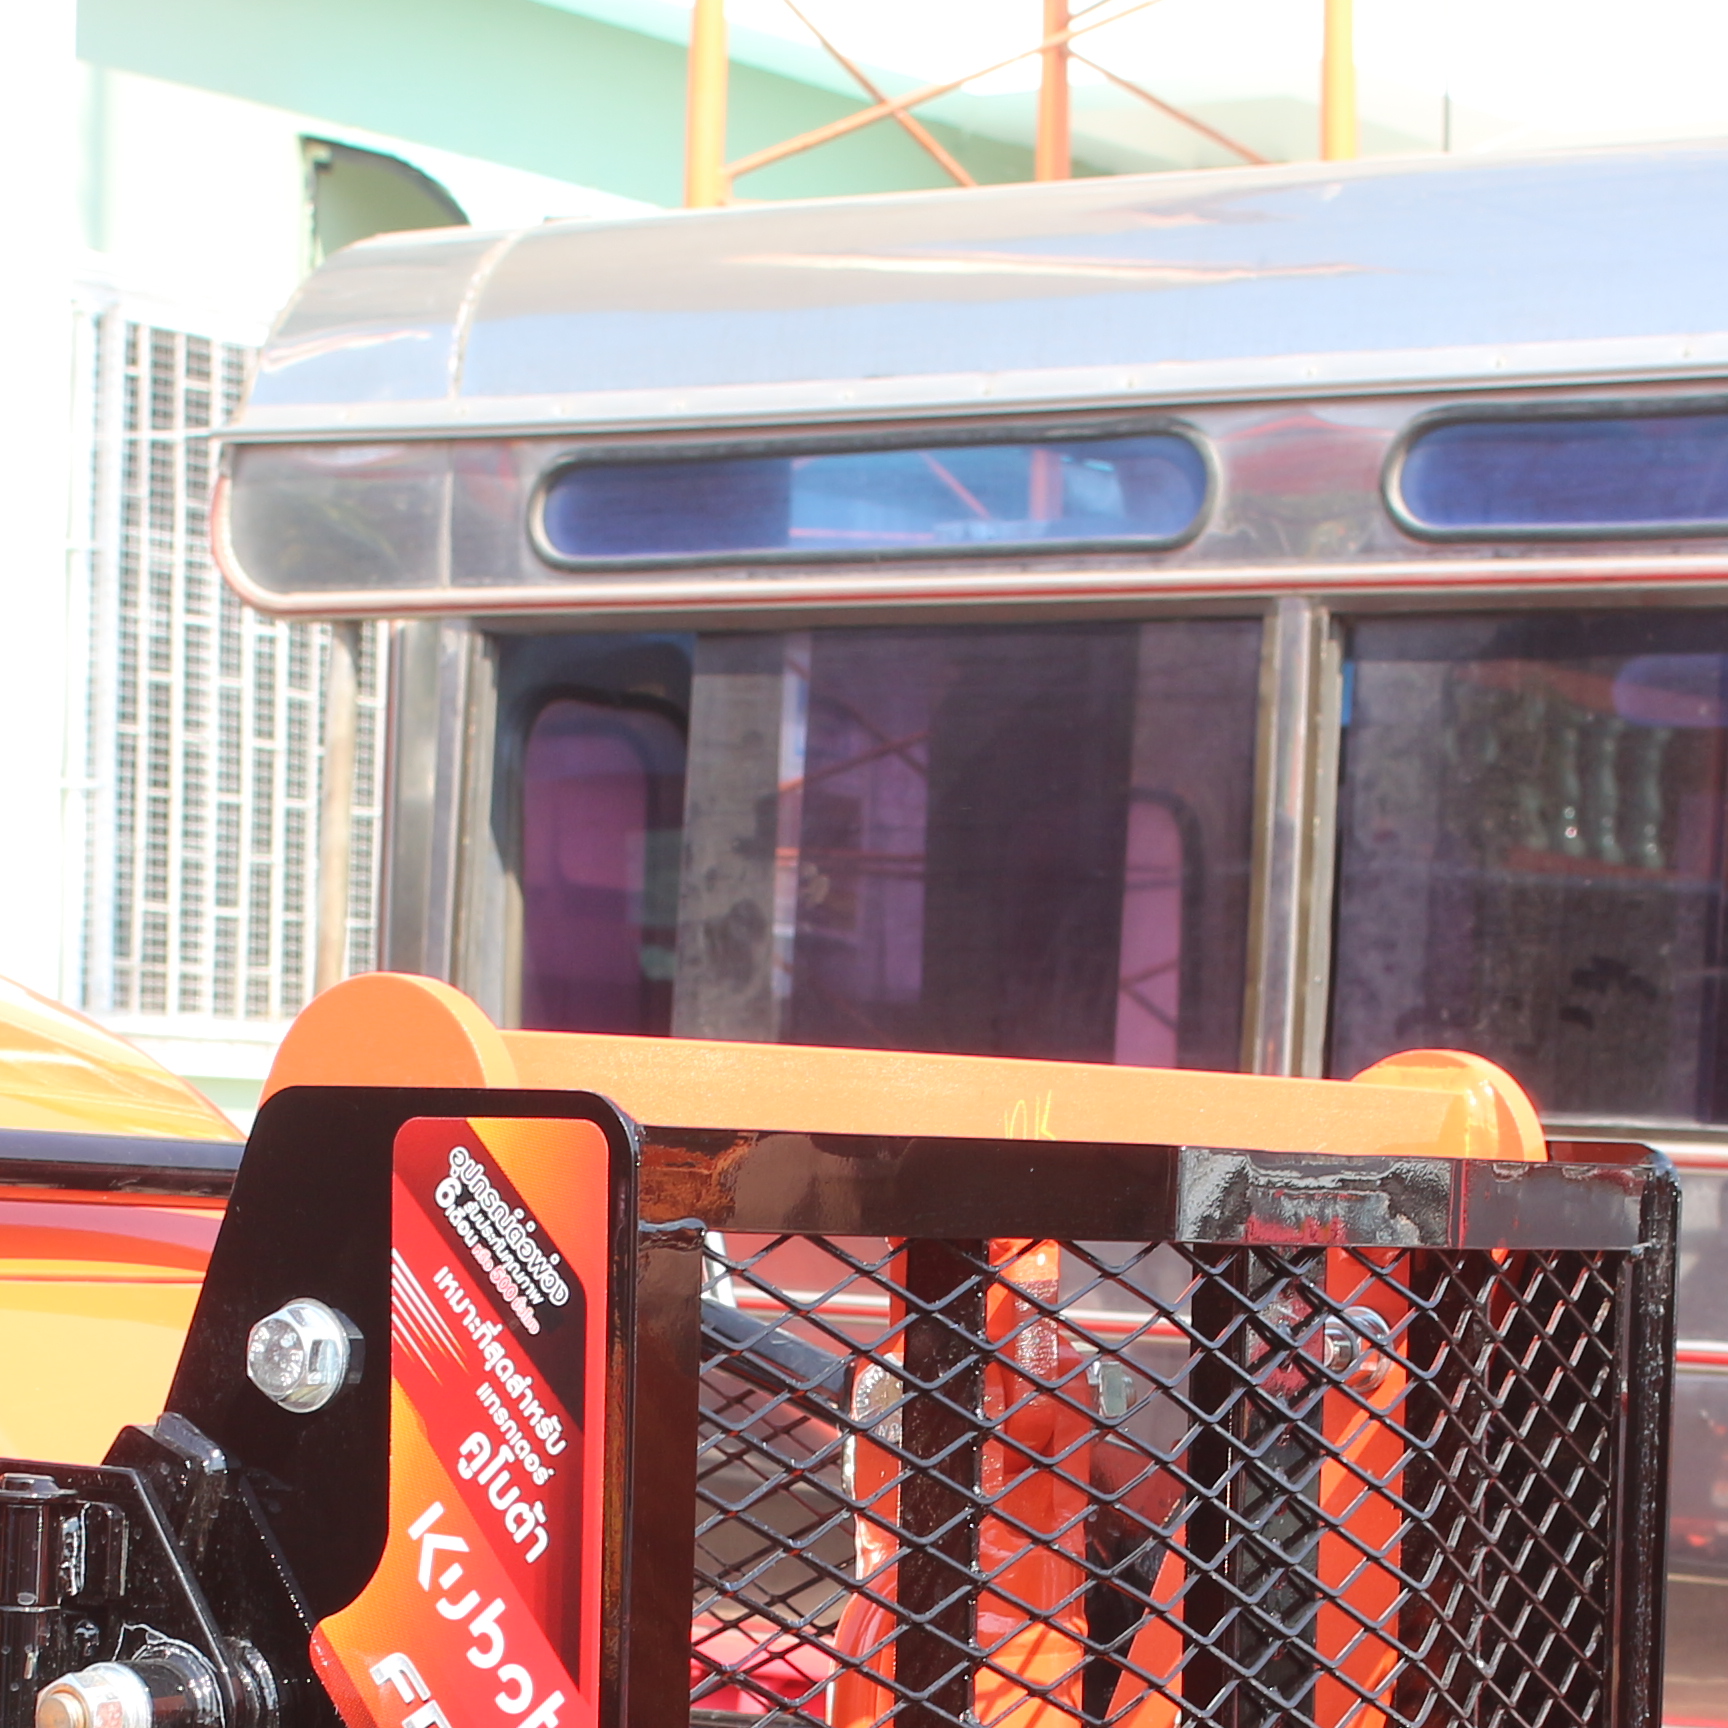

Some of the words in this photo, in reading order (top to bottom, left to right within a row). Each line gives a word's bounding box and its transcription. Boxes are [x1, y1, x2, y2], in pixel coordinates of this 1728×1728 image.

[433, 1177, 462, 1209] 6
[489, 1263, 518, 1303] 500
[448, 1145, 569, 1306] อุปกรณ์ต่อพ่วง
[463, 1202, 545, 1305] รับประกันคุณภาพ
[432, 1266, 567, 1457] เหมาะที่สุดสำหรับ
[458, 1431, 551, 1564] คูโบต้า
[475, 1381, 556, 1487] แทรกเตอร์
